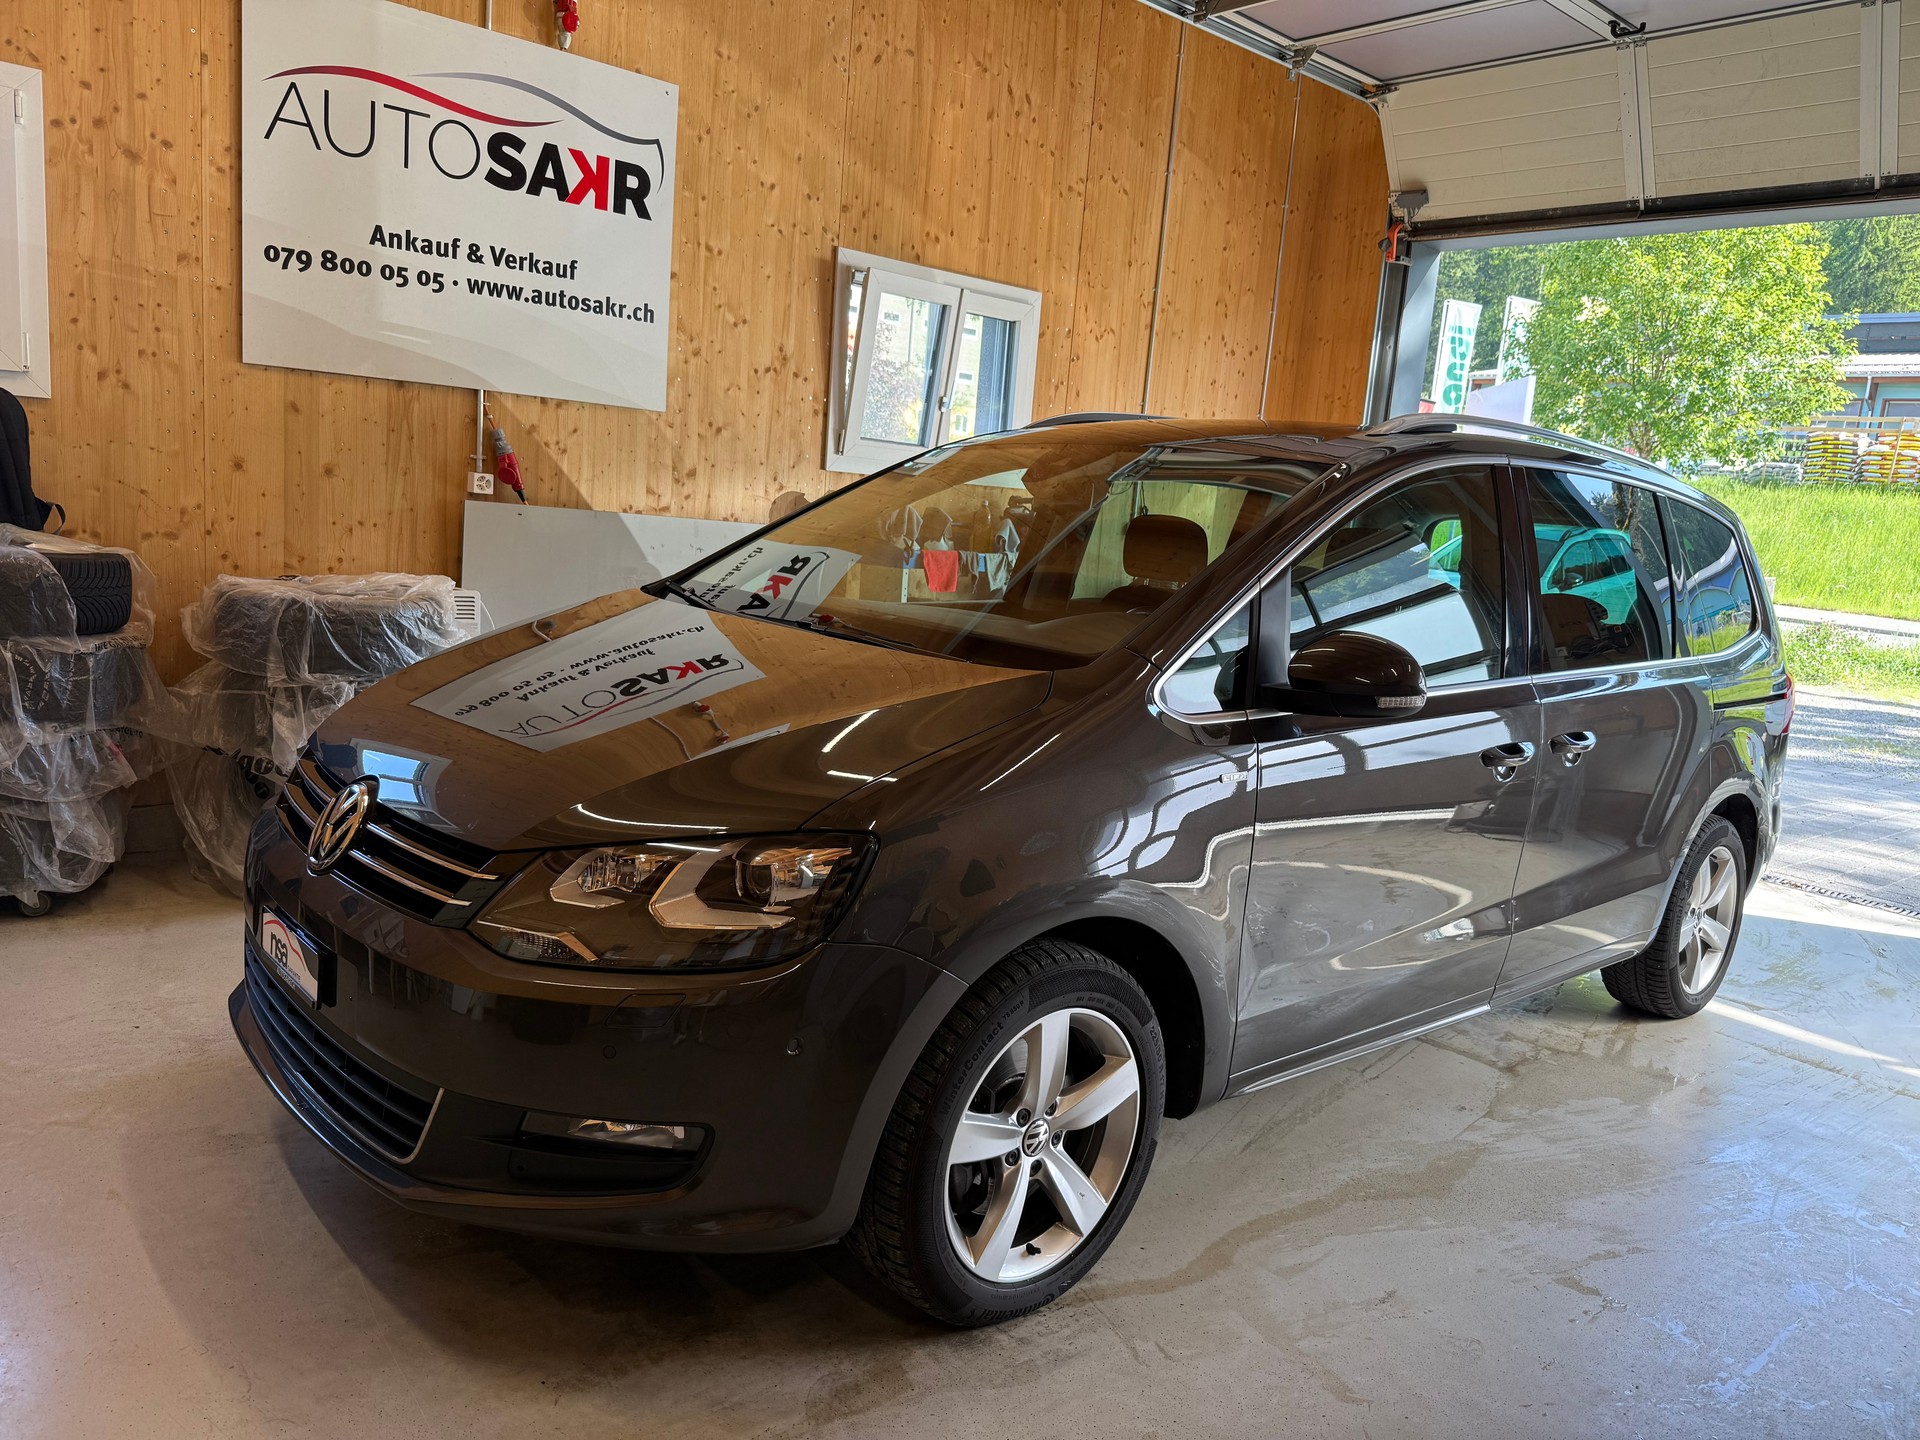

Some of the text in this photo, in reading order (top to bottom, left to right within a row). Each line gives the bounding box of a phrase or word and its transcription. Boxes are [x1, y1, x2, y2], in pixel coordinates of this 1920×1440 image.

[264, 81, 652, 221] AUTOSAKR
[263, 244, 655, 324] 079 800 05 05 www.autosakr.ch
[369, 224, 578, 281] Ankauf & Verkauf
[1443, 325, 1472, 414] andi
[940, 1021, 1004, 1117] WinterContact
